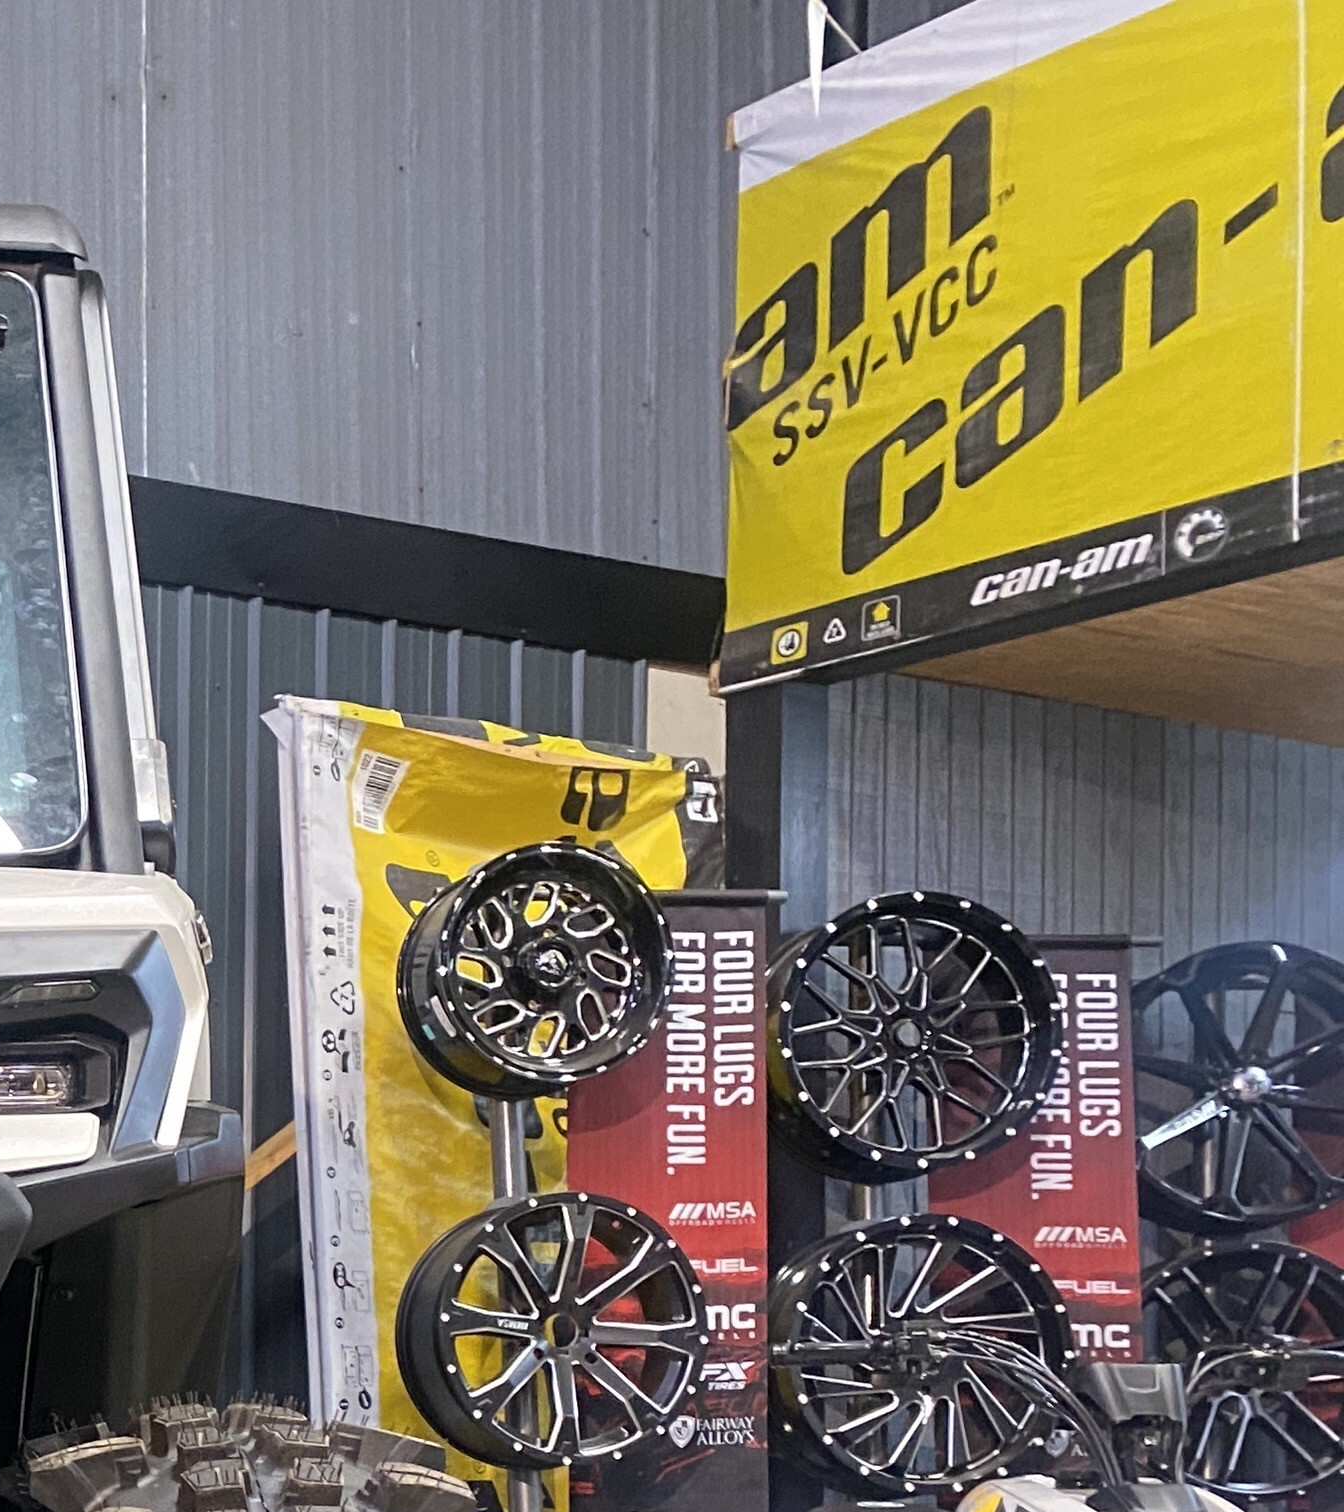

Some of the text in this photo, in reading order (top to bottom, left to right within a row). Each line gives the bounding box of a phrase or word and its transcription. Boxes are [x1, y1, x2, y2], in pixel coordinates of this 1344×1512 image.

[772, 234, 999, 467] SSV-VCC
[841, 84, 1344, 576] can-
[969, 533, 1154, 608] can-am
[666, 1003, 706, 1094] MORE
[713, 930, 756, 1107] FOUR LUGS
[1075, 973, 1122, 1137] FOUR LUGS
[666, 1104, 707, 1176] FUN.
[1030, 1133, 1074, 1200] FUN.
[706, 1201, 757, 1219] MSA
[1075, 1226, 1128, 1243] MSA
[688, 1257, 759, 1274] FUEL
[1052, 1280, 1132, 1294] FUEL
[696, 1416, 756, 1431] FAIRWAY
[696, 1430, 756, 1446] ALLOYS
